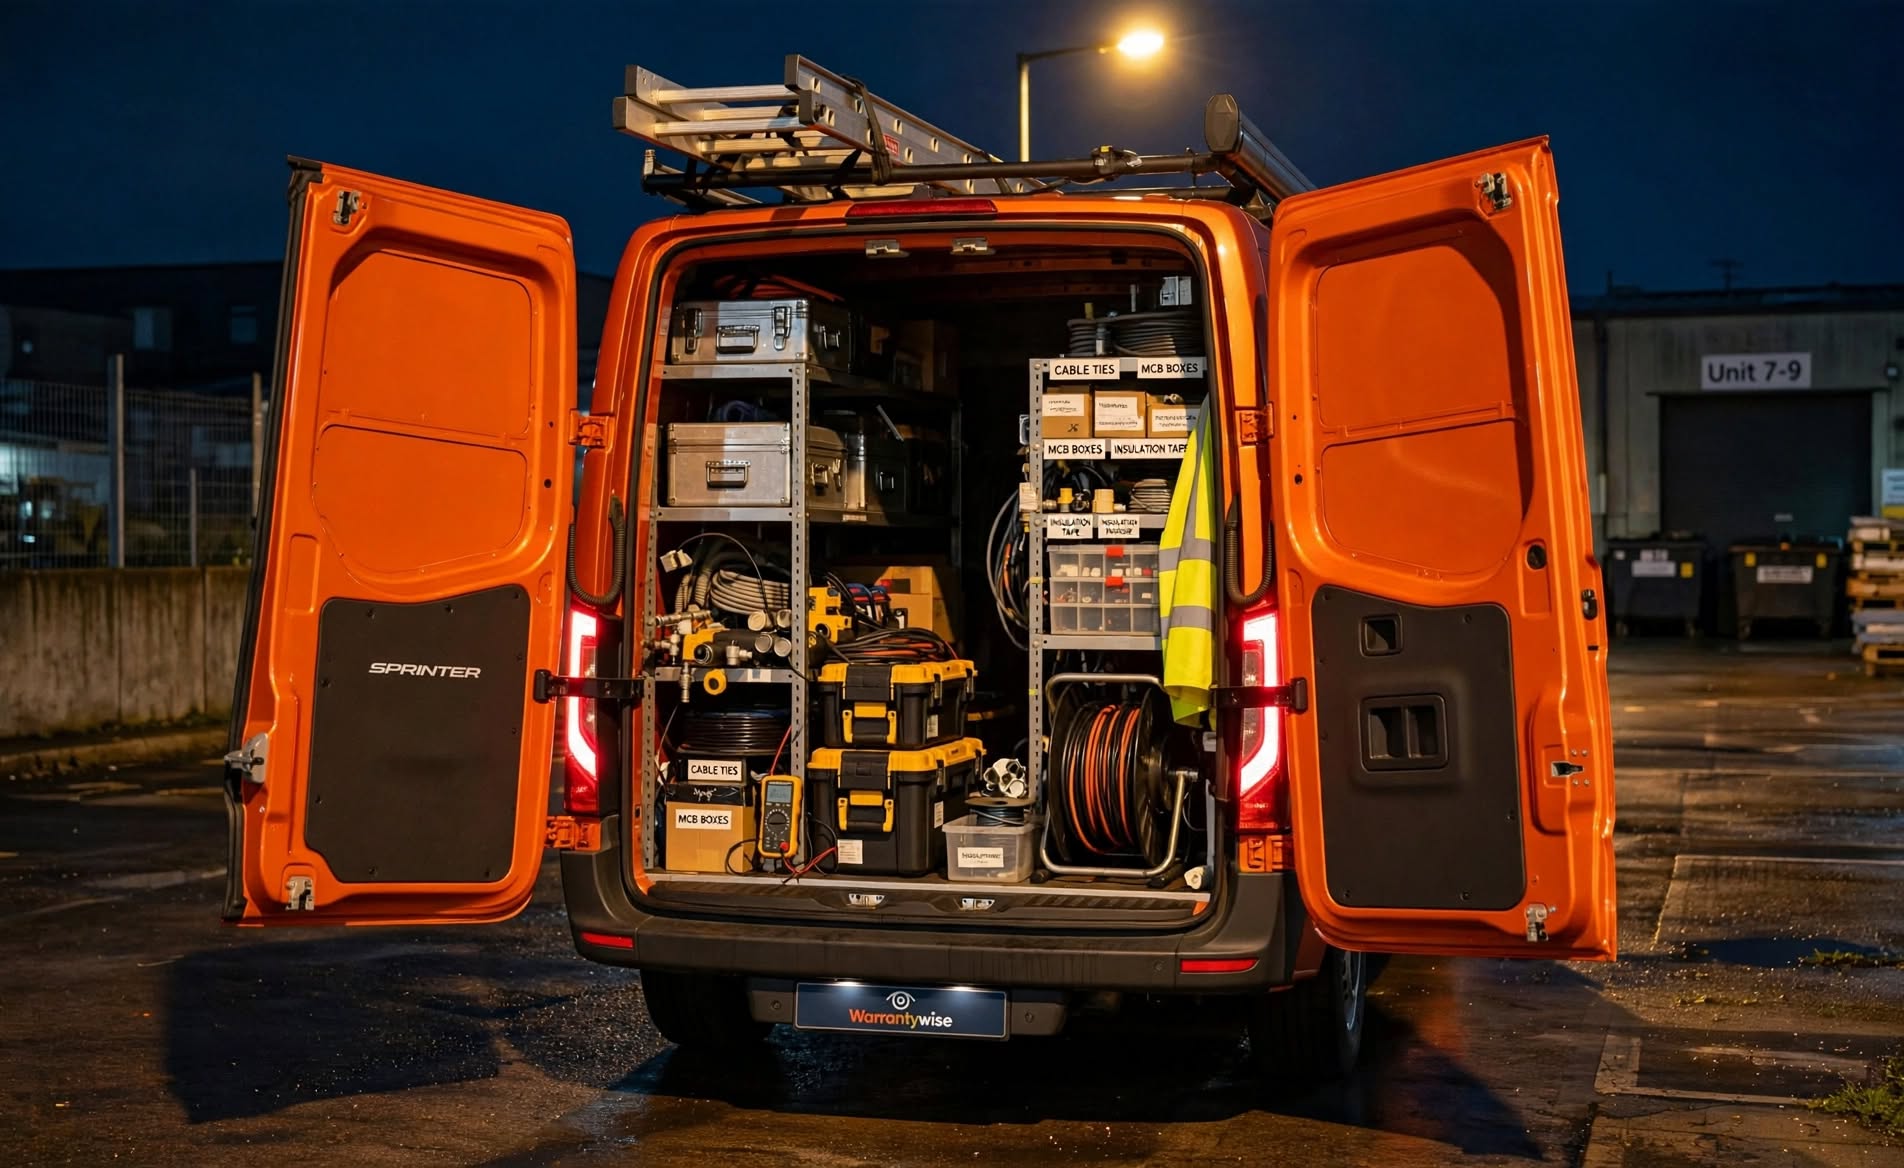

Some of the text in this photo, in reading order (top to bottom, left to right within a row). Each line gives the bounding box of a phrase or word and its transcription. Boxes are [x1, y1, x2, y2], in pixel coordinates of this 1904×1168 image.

[1054, 364, 1115, 376] CABLE TIES
[1141, 363, 1199, 374] MCB BOXES
[1708, 360, 1802, 382] Unit 7-9
[1048, 444, 1103, 455] MCB BOXES
[1114, 444, 1166, 454] INSULATION
[368, 662, 482, 679] SPRINTER
[691, 765, 738, 776] CABLE TIES
[678, 814, 729, 825] MCB BOXES
[848, 1008, 953, 1029] Warrantywise
